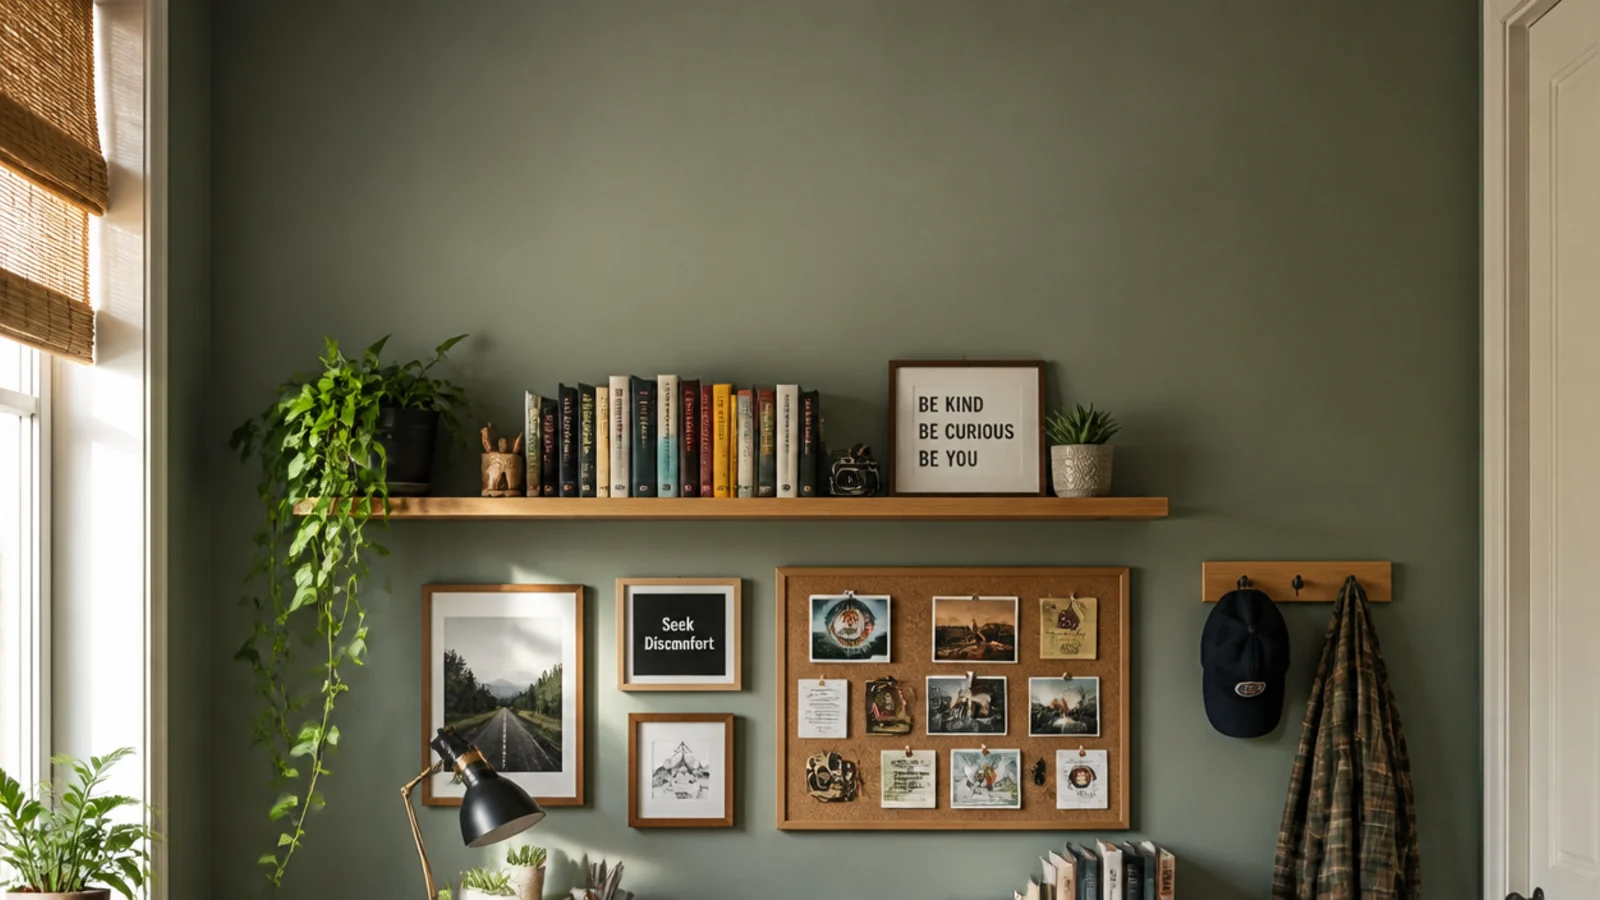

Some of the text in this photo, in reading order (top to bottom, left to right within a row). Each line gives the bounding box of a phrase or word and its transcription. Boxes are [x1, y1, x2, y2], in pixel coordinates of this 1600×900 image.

[918, 395, 984, 413] BE KIND
[918, 422, 1015, 440] BE CURIOUS
[918, 449, 978, 467] BE YOU
[662, 616, 695, 632] Seek
